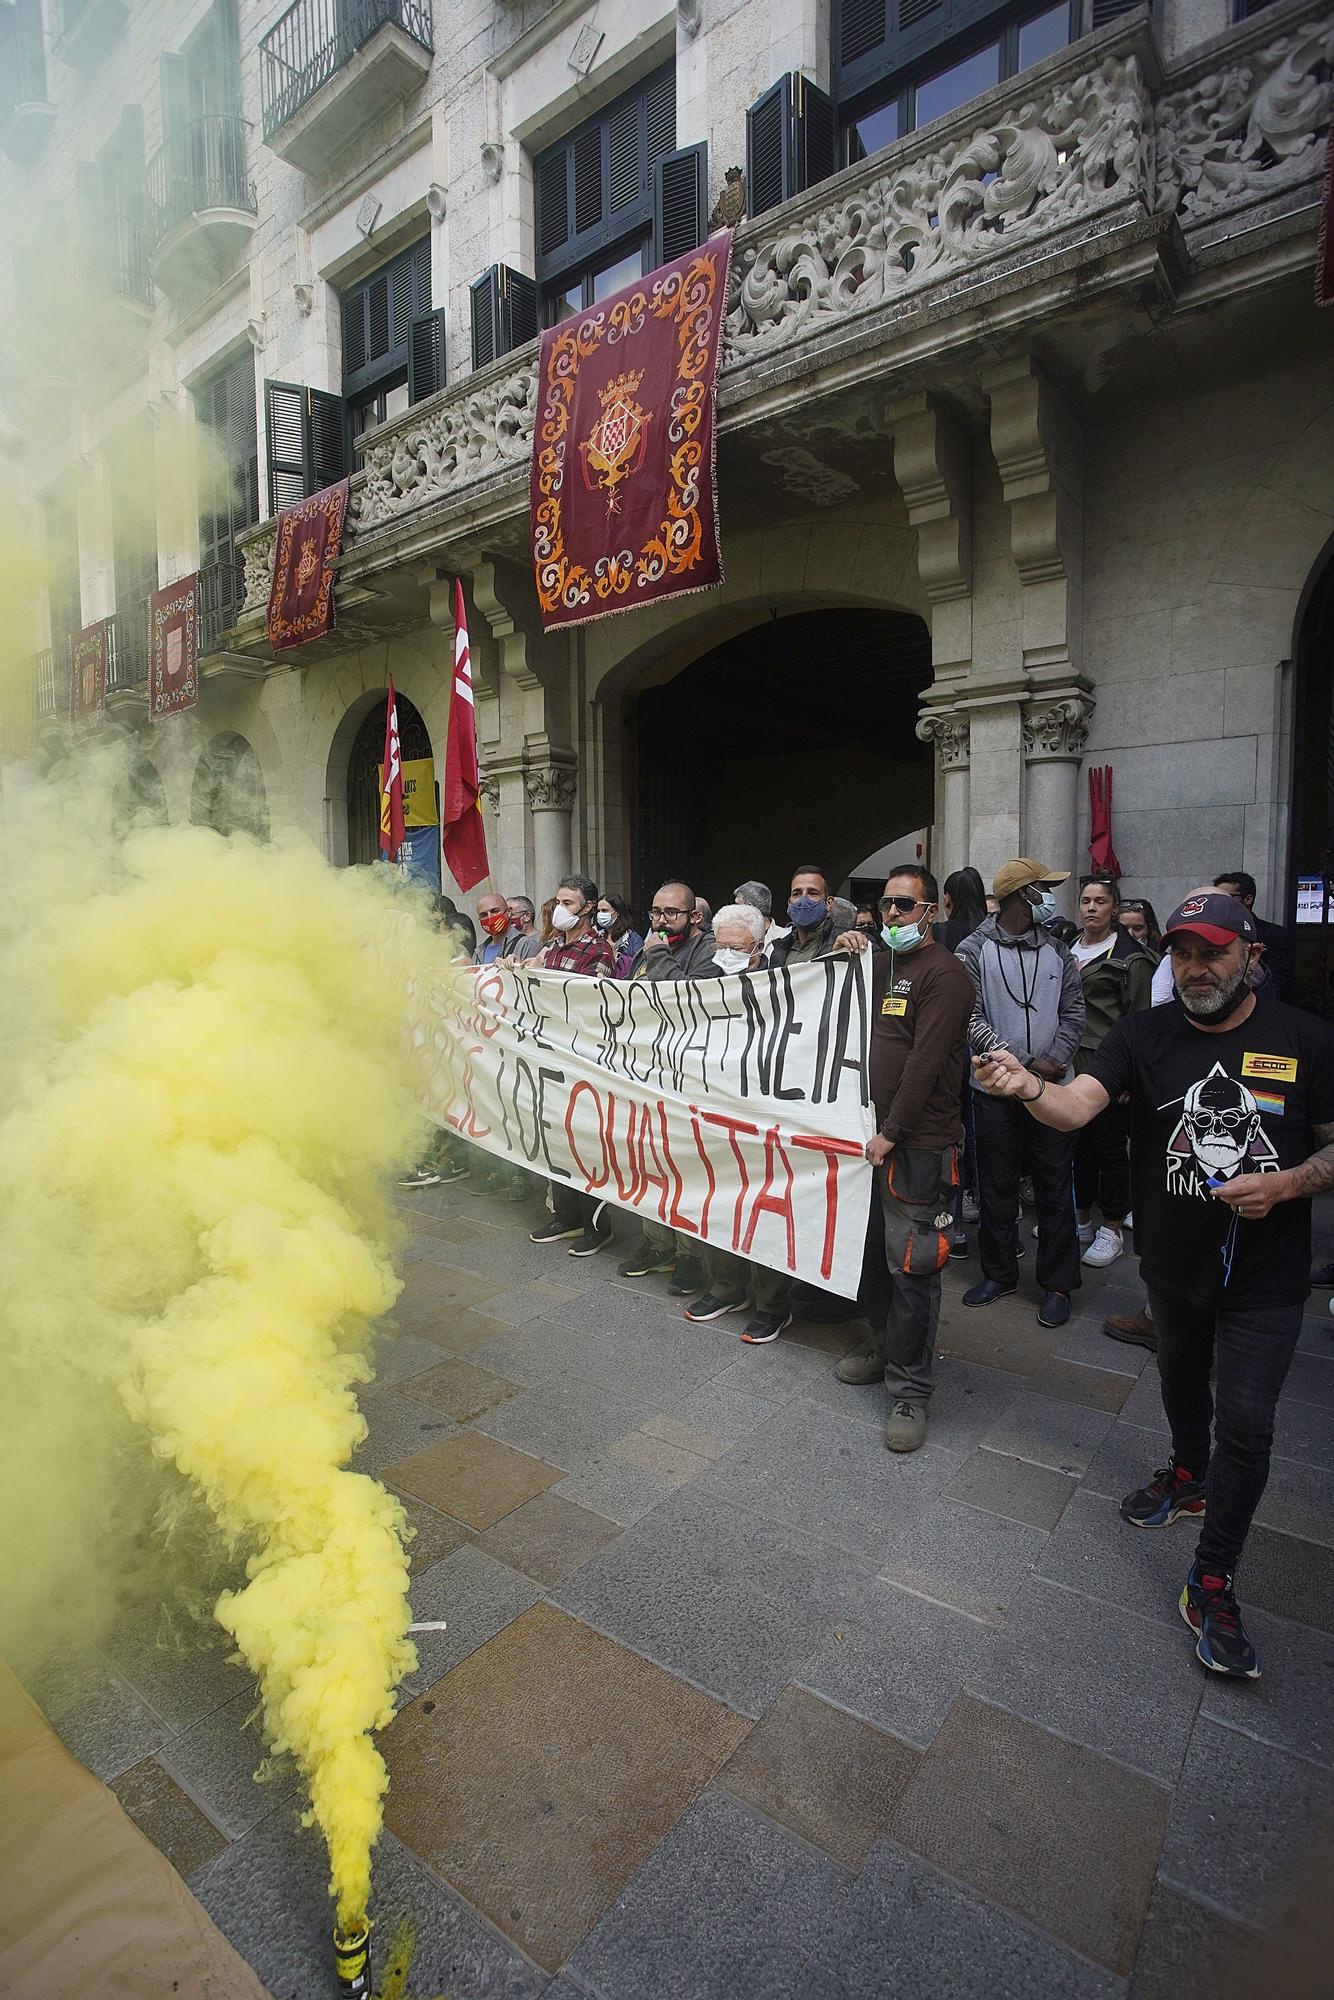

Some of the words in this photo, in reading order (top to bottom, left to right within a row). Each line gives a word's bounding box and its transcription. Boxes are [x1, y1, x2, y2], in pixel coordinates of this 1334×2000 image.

[513, 974, 556, 1051] DE
[739, 951, 869, 1108] NETA
[513, 1057, 571, 1179] DE
[1166, 1156, 1207, 1202] PINK
